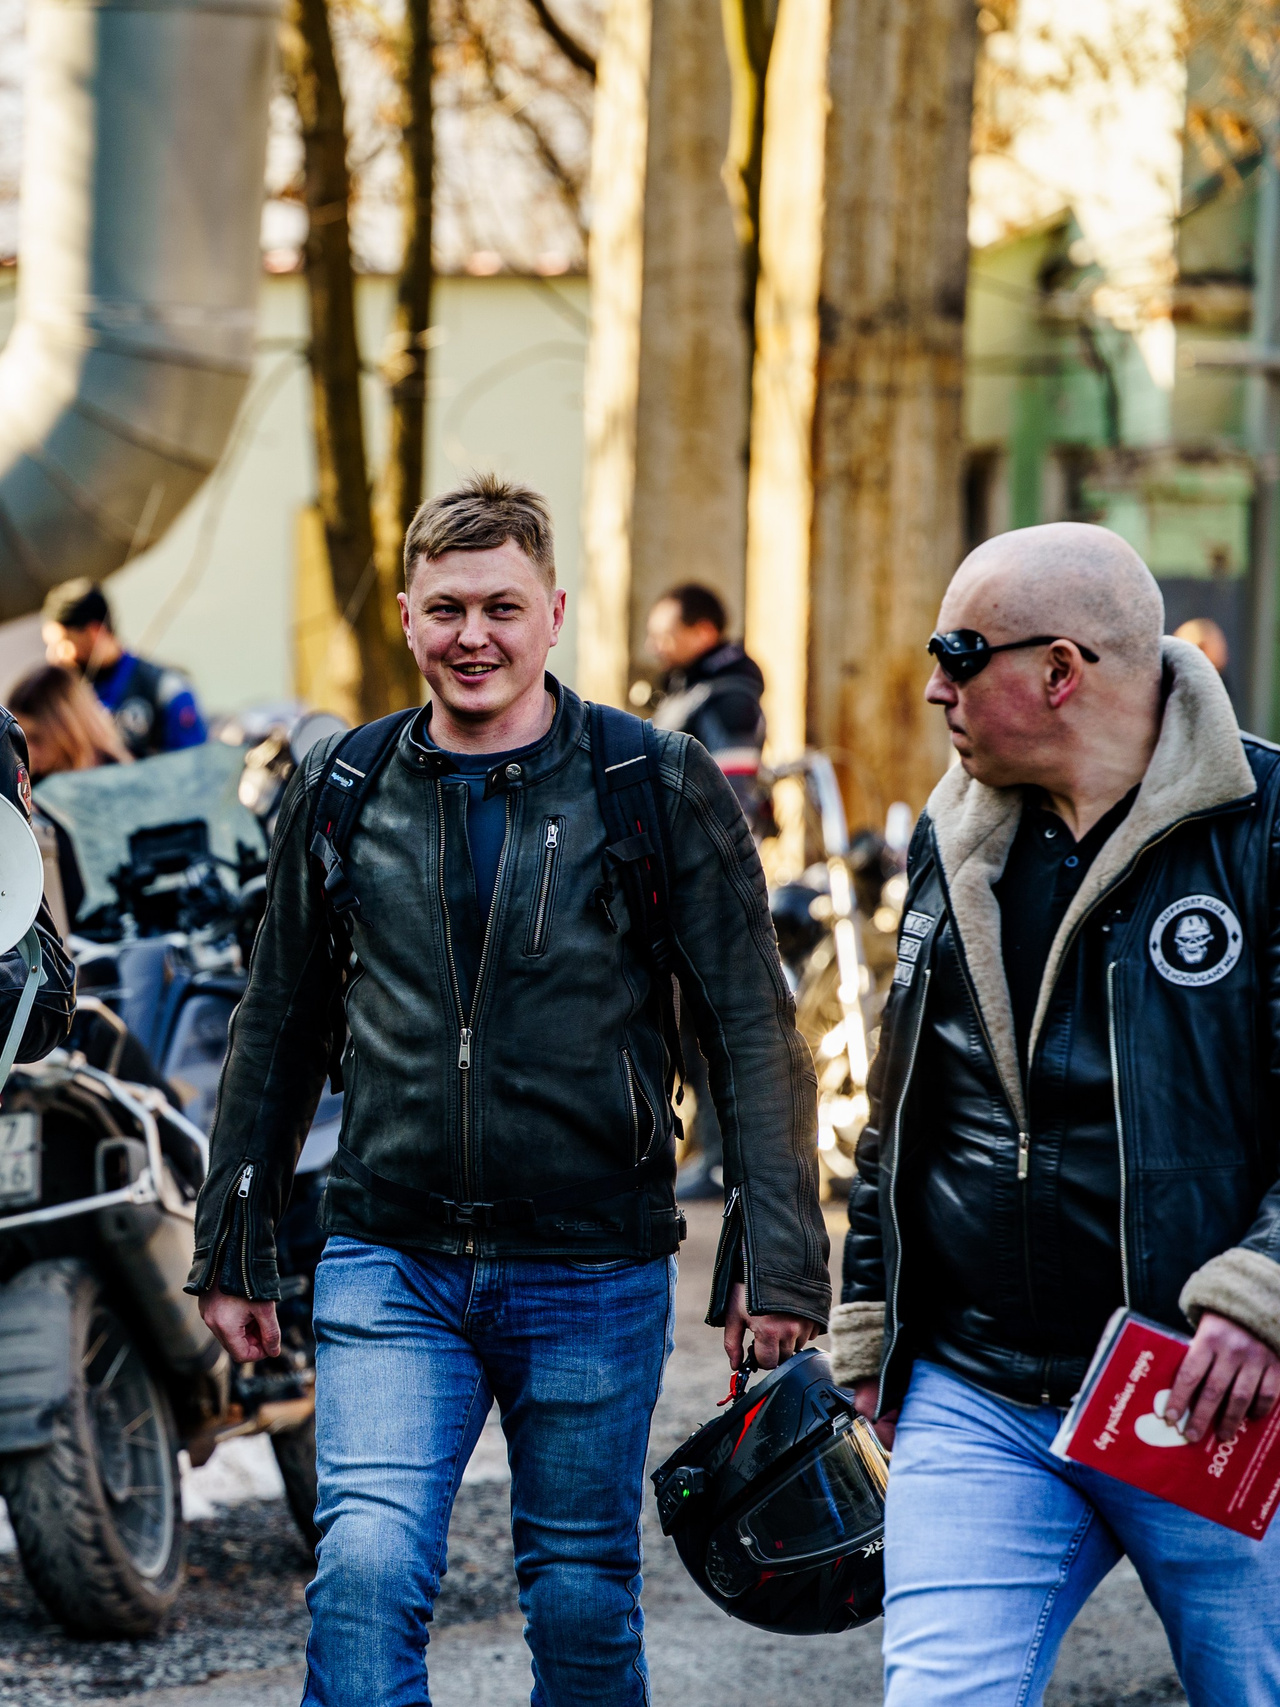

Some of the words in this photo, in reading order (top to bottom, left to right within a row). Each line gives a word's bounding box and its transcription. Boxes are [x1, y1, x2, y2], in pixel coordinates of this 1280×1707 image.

[1160, 897, 1203, 923] SUPPORT
[1204, 899, 1227, 916] CLUB
[1171, 966, 1225, 984] HOOLIGANS
